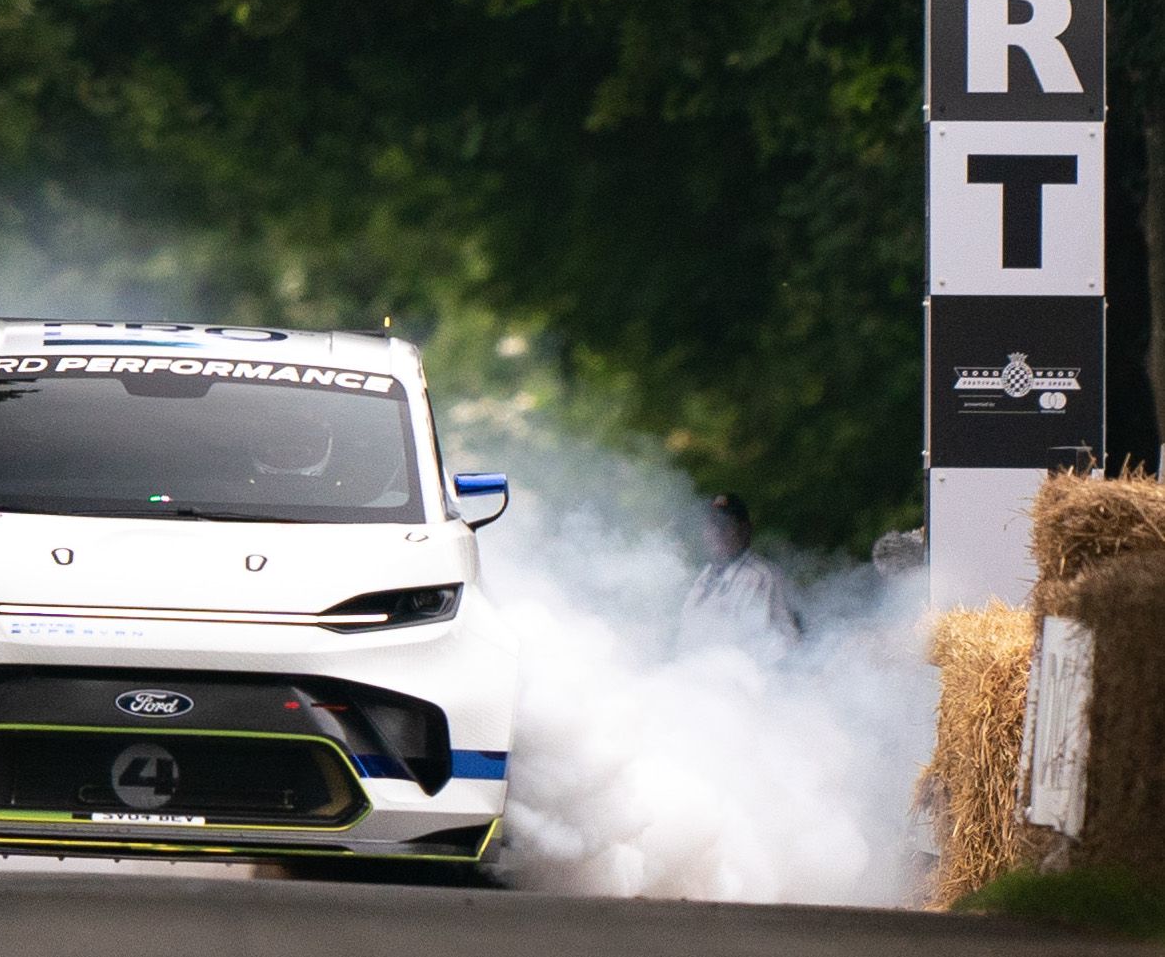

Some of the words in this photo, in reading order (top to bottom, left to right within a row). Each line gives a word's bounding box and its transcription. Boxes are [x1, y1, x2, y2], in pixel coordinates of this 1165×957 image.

[54, 357, 395, 394] PERFORMANCE
[129, 693, 181, 713] Ford
[118, 756, 177, 796] 4
